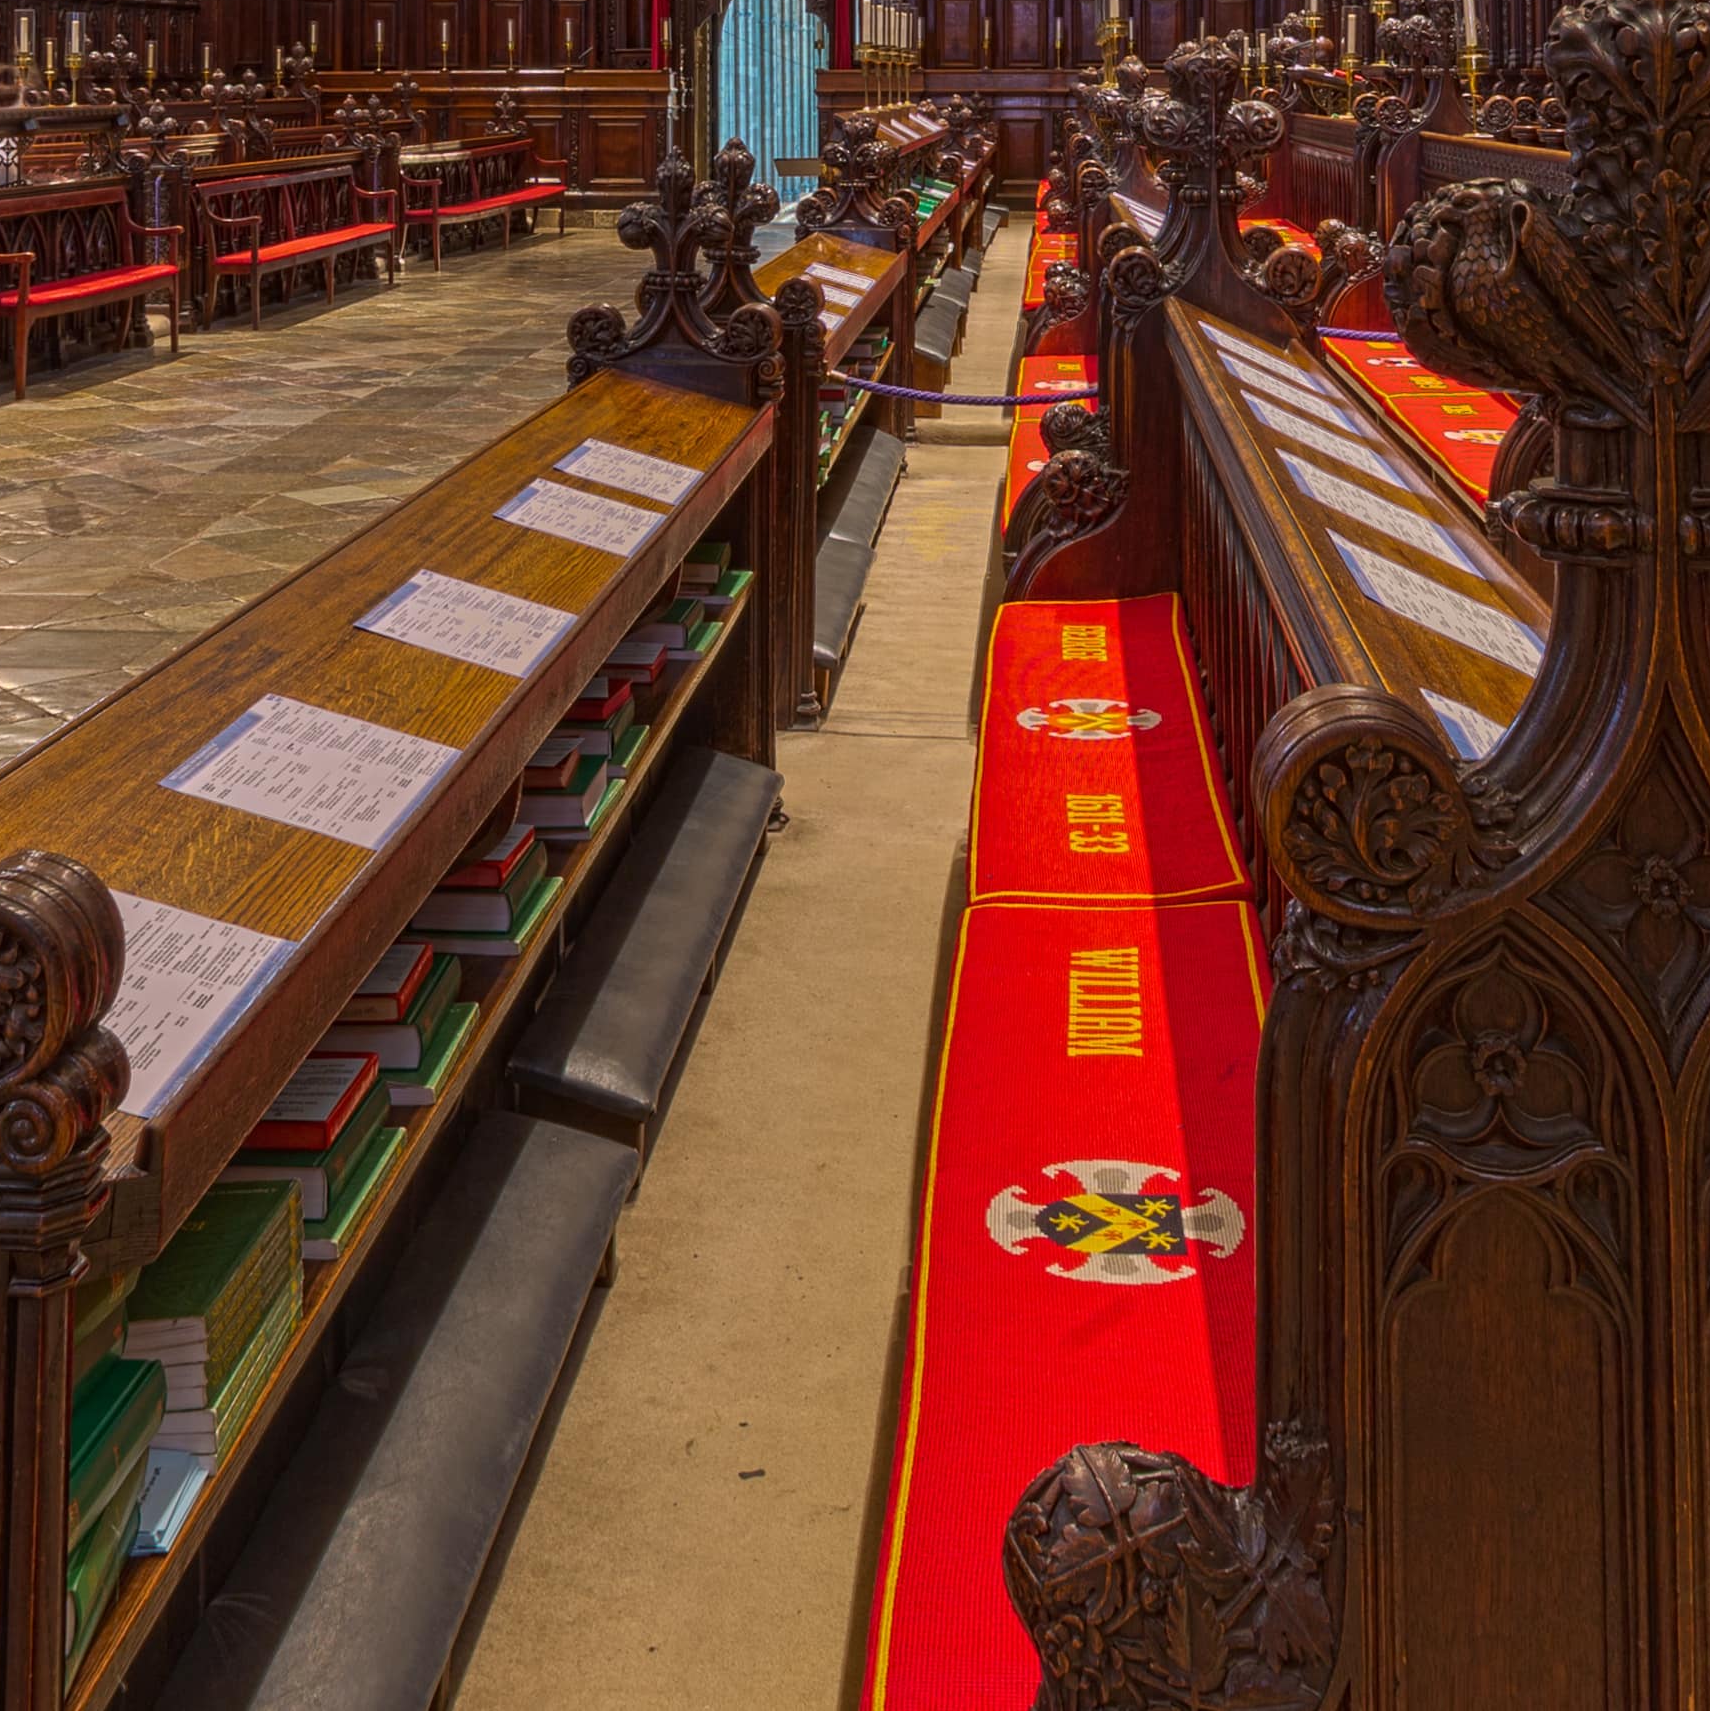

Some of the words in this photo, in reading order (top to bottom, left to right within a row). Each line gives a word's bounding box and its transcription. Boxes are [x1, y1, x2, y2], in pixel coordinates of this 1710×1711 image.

[1061, 625, 1109, 662] GEORGE
[1066, 793, 1130, 854] 1611-33
[1067, 947, 1143, 1057] WILLIAM
